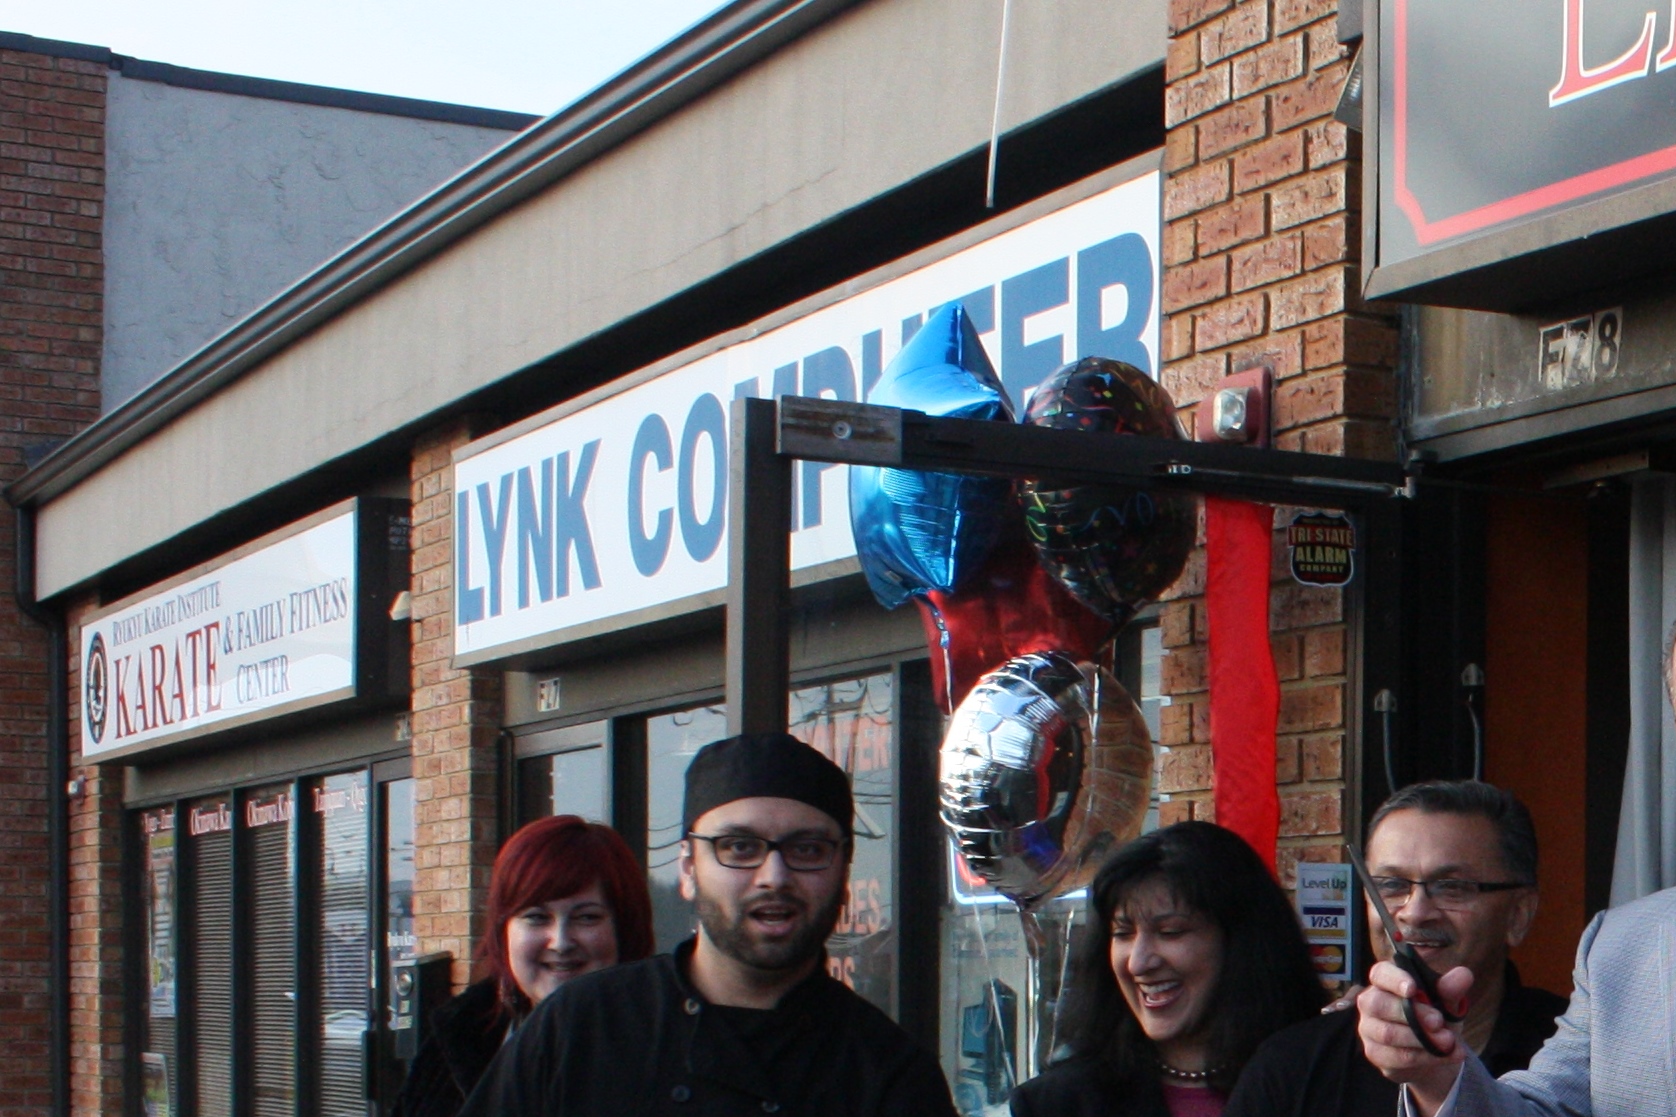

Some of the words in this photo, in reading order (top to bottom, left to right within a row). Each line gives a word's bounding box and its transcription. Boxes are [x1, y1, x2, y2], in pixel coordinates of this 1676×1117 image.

[457, 438, 602, 626] LYNK
[628, 232, 1154, 578] COPER
[1296, 546, 1347, 563] ALARM
[145, 599, 176, 636] KARATE
[178, 581, 221, 622] INSTITUTE
[114, 621, 222, 739] KARATE
[223, 616, 233, 655] &
[237, 599, 286, 650] FAMILY
[289, 577, 348, 634] FITNESS
[237, 655, 290, 705] CENTER
[1311, 916, 1338, 928] VISA
